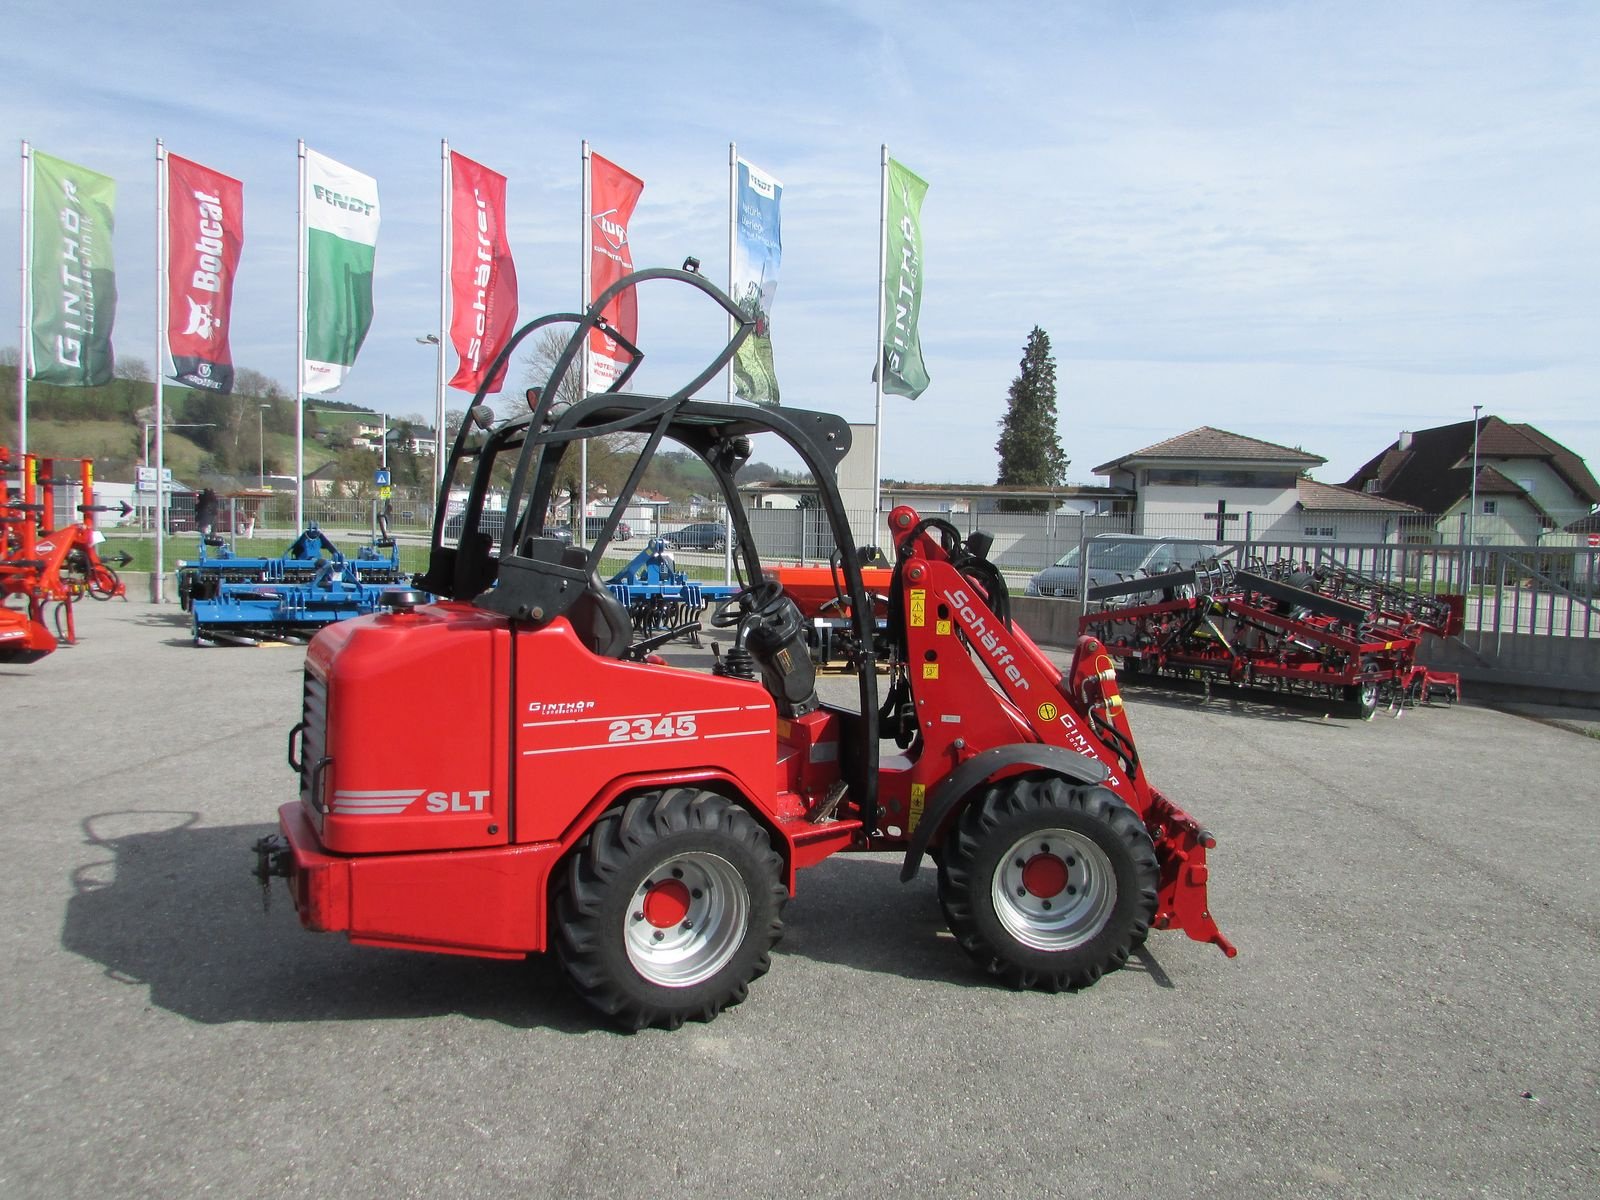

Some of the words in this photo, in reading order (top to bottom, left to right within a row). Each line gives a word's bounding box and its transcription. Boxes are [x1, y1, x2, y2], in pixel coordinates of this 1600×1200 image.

[192, 191, 224, 293] Bobcat
[313, 184, 375, 217] FENDT
[56, 177, 85, 368] GINTHÖR
[467, 188, 492, 372] Schäffer
[943, 589, 1030, 690] Schäffer
[608, 715, 697, 743] 2345
[1060, 713, 1120, 787] GINTR
[426, 790, 490, 813] SLT
